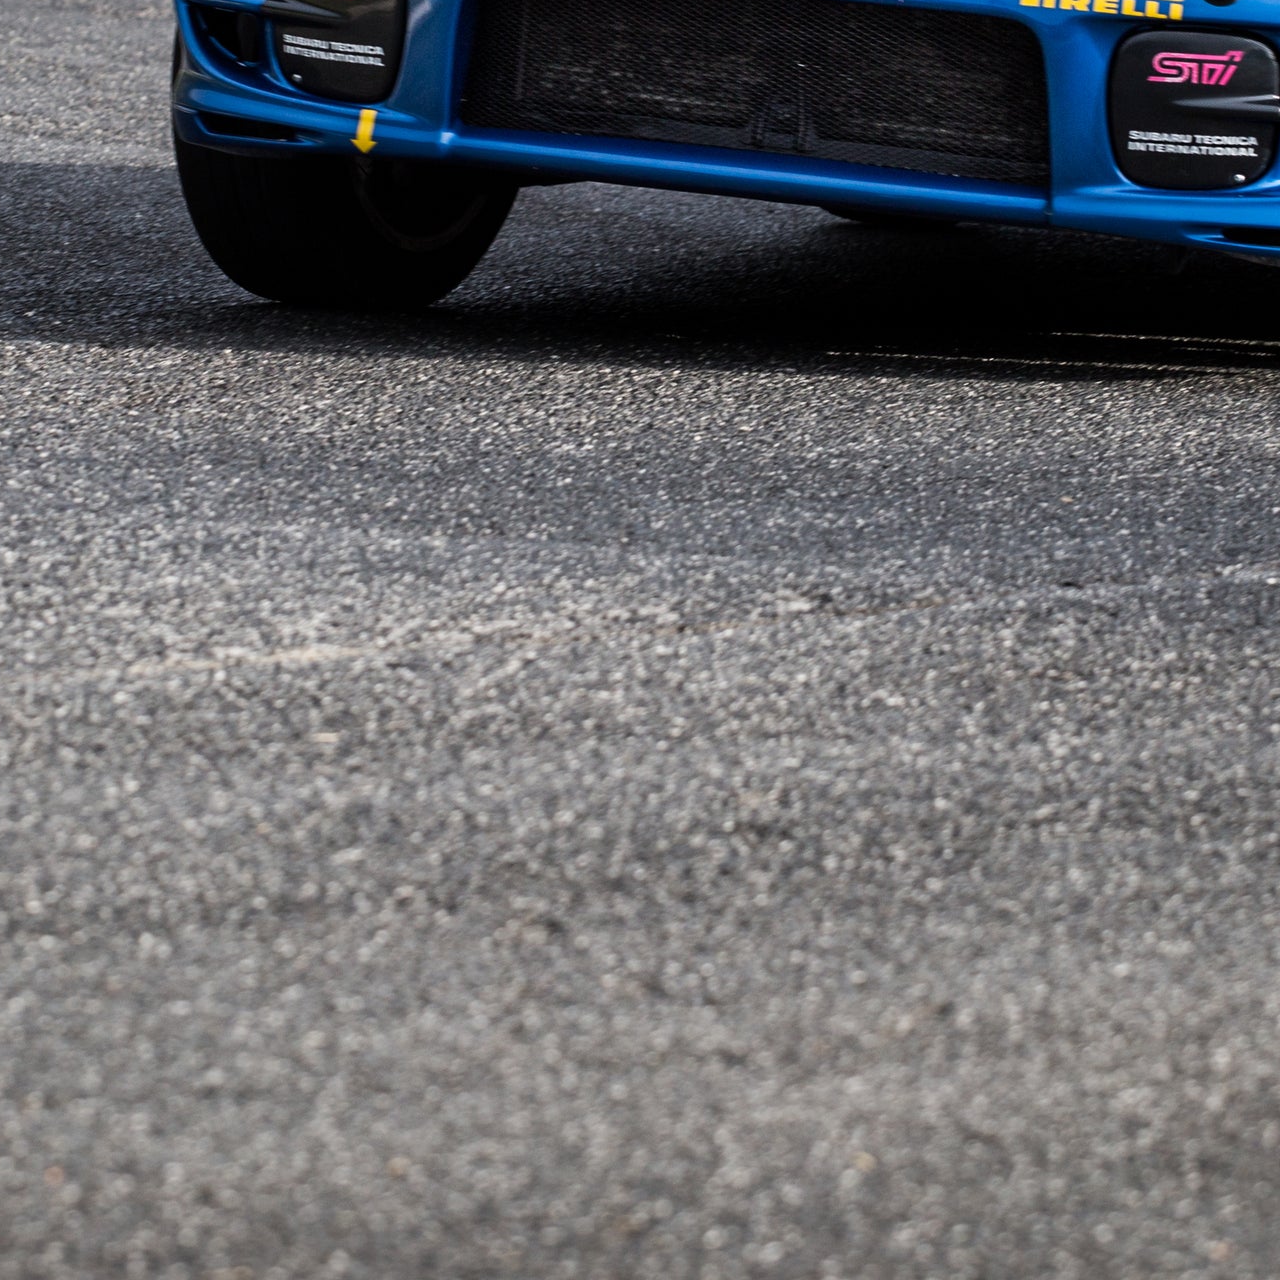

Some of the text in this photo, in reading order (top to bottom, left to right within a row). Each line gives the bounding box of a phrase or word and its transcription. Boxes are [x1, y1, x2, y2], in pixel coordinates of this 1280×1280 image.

[282, 33, 385, 56] SUBARU TECNICA
[283, 44, 385, 67] INTERNATIONAL
[1128, 129, 1259, 146] SUBARU TECNICA
[1127, 141, 1259, 157] INTERNATIONAL
